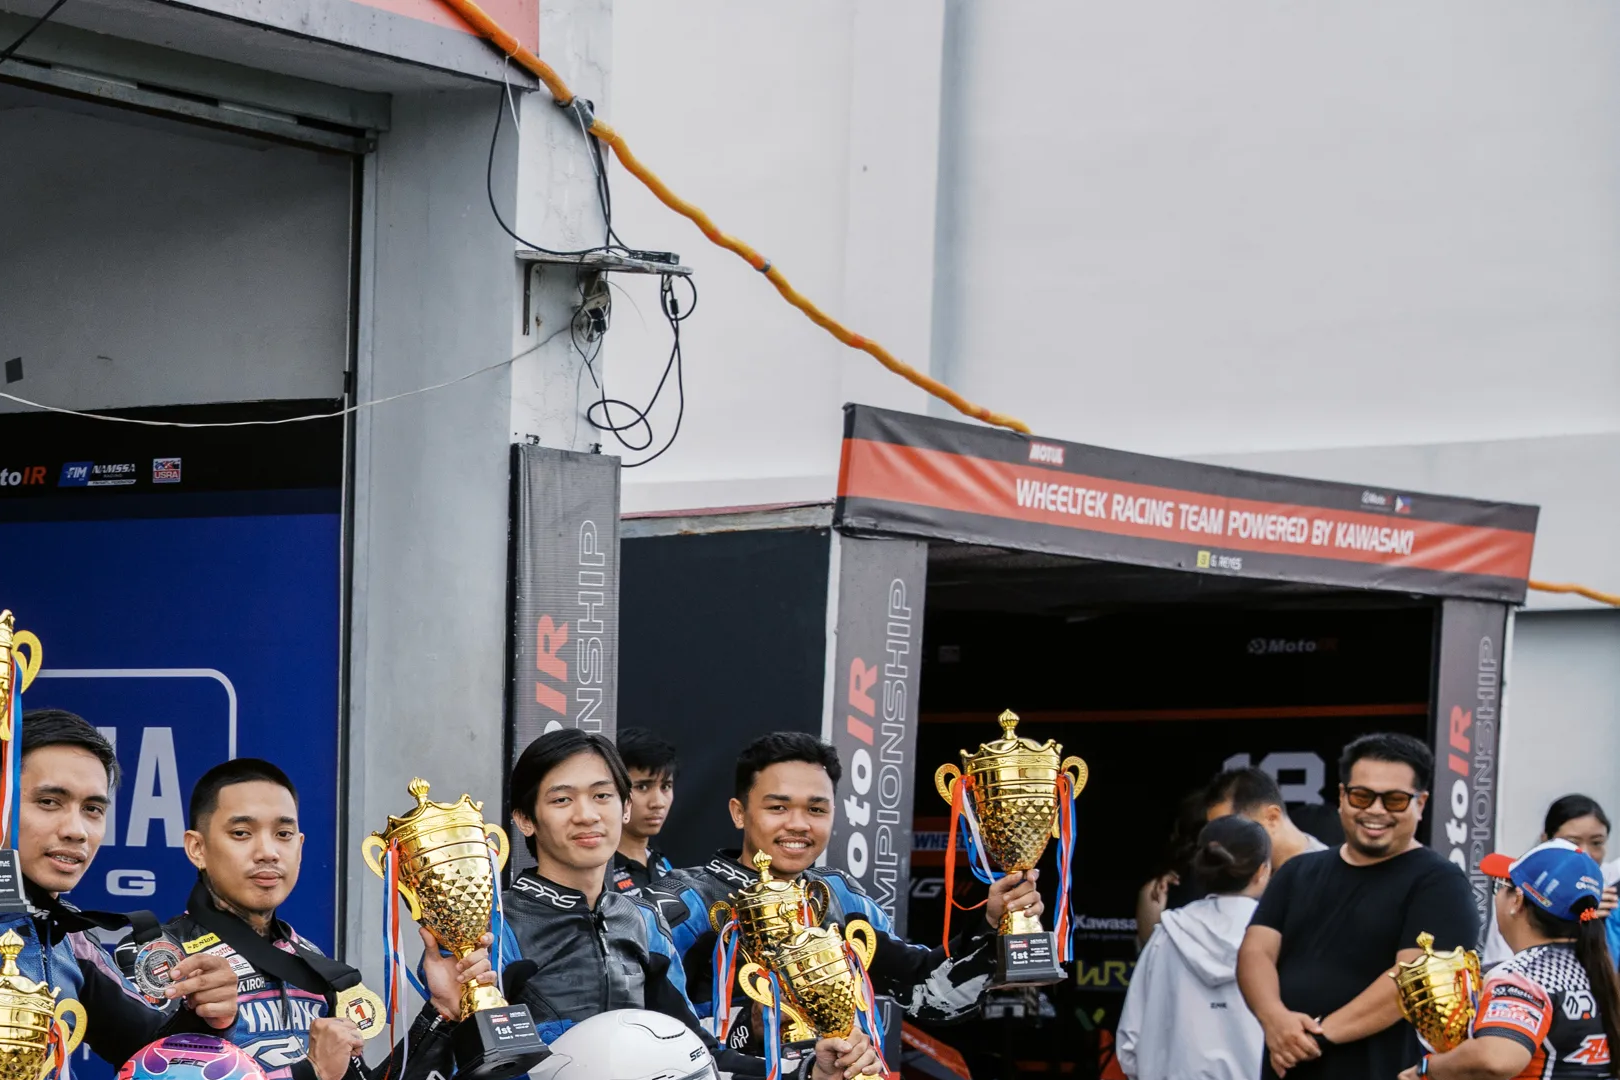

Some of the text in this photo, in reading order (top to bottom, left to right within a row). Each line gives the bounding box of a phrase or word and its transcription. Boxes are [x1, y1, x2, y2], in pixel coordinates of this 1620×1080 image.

[1030, 443, 1064, 464] MOTUL
[154, 470, 180, 480] USRA
[1015, 477, 1415, 556] WHEELTEK RACING TEAM POWERED BY KAWASAKI
[844, 656, 878, 885] otoIR
[1075, 915, 1138, 931] Kawasa
[210, 945, 233, 957] Castro
[1011, 951, 1029, 960] 1st
[1076, 960, 1138, 986] WR
[355, 1004, 367, 1020] 1
[495, 1025, 513, 1035] 1st
[689, 1047, 707, 1063] SEC
